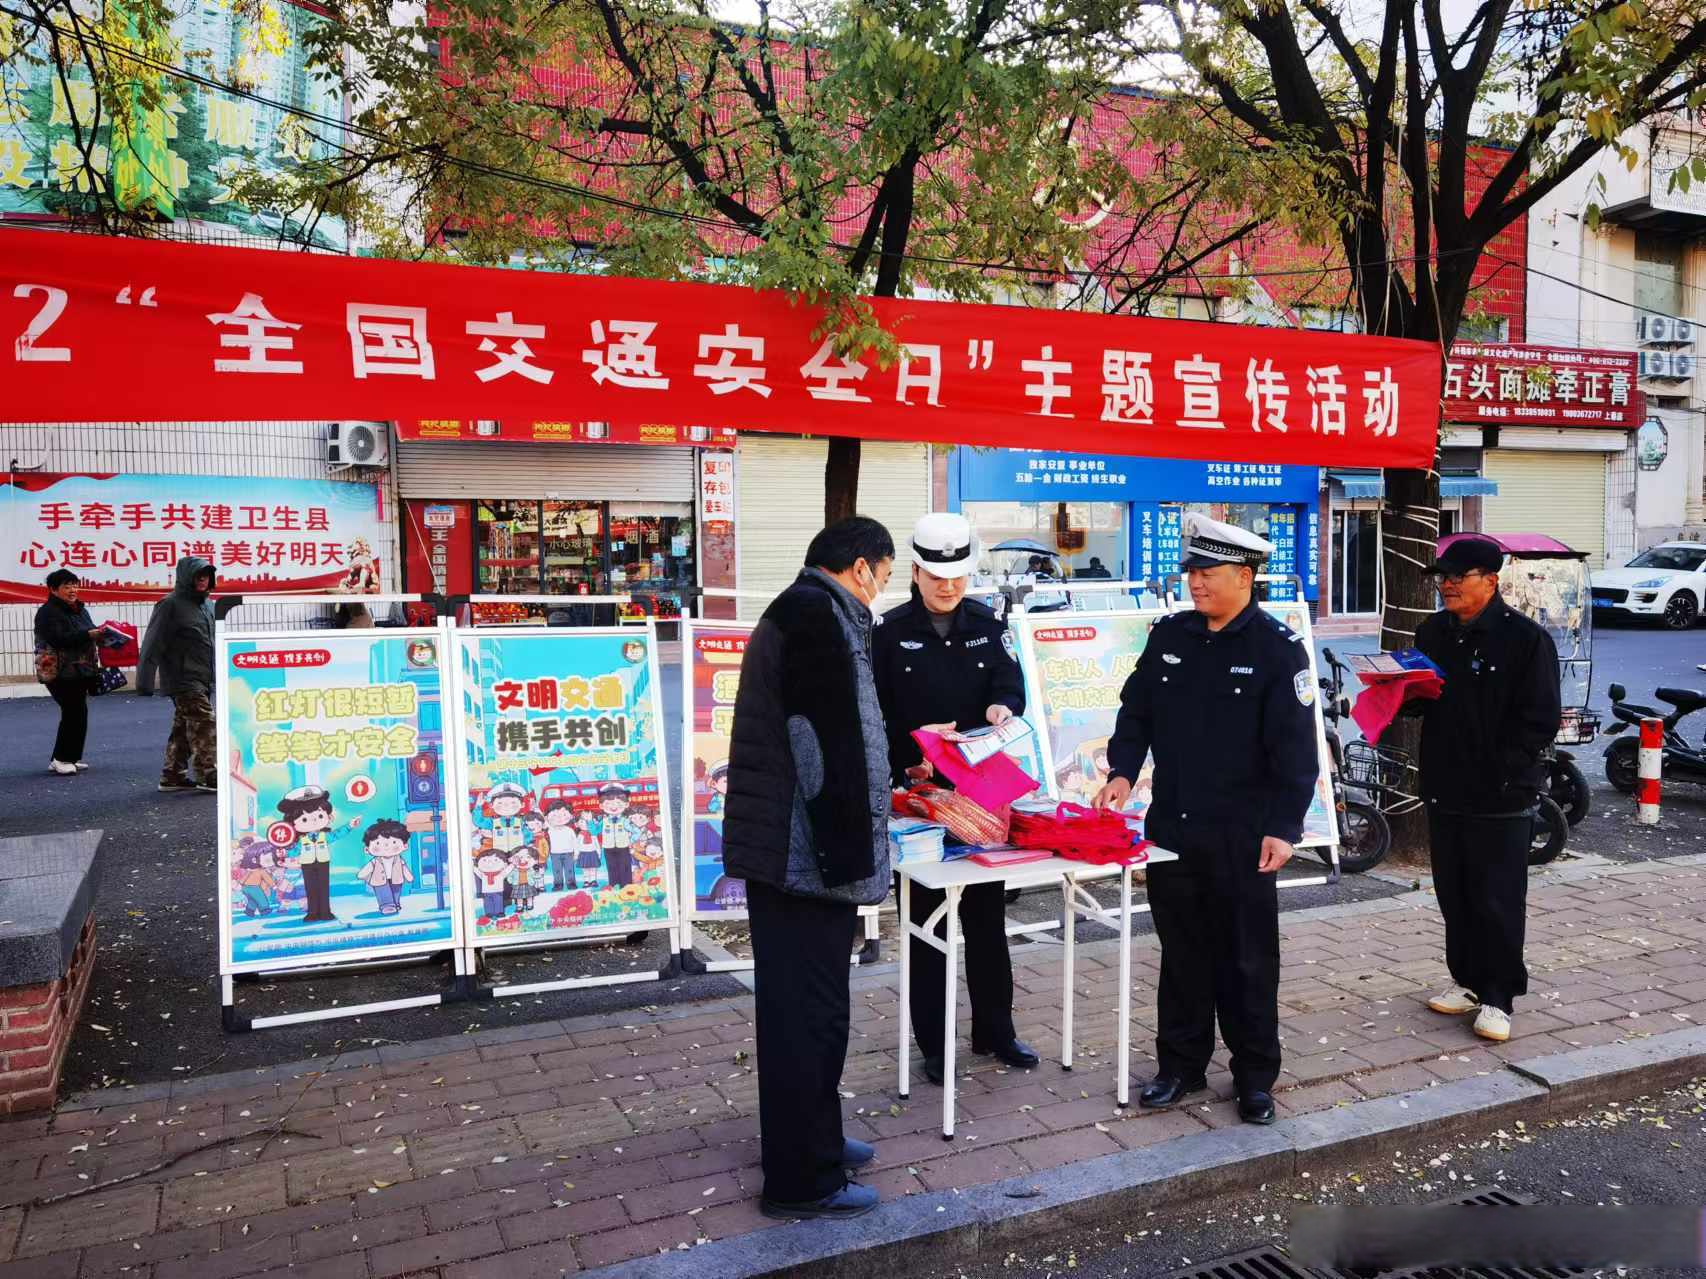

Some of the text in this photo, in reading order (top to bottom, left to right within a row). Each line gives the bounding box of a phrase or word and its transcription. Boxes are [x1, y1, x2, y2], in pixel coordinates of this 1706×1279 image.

[38, 502, 330, 533] 手牵手共建卫生县
[20, 540, 345, 569] 心连心同谱美好明天
[255, 685, 416, 721] 红灯很短暂
[494, 676, 623, 710] 文明交通
[255, 727, 417, 763] 等等才安全
[496, 717, 628, 752] 携手共创
